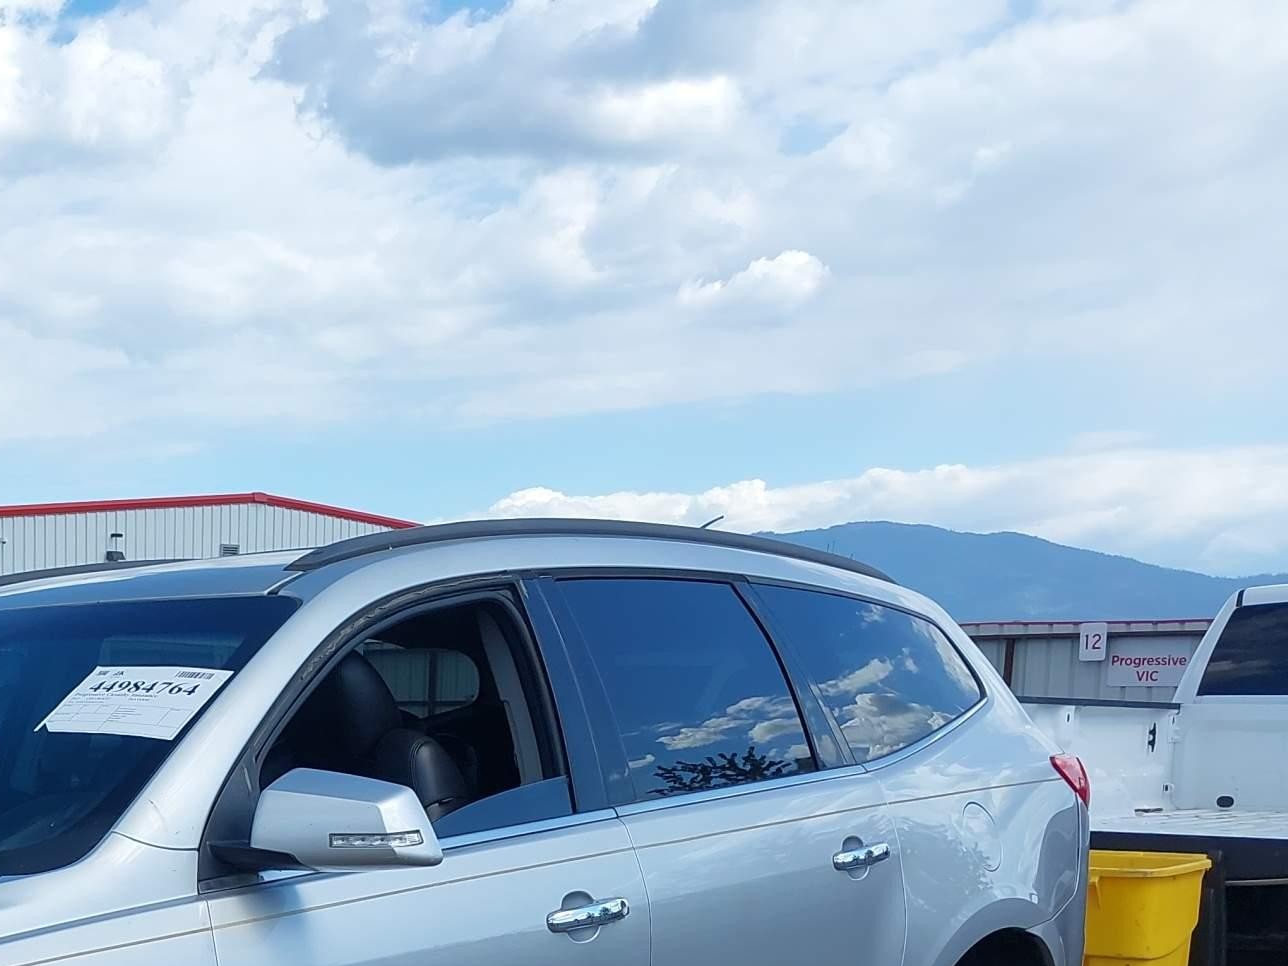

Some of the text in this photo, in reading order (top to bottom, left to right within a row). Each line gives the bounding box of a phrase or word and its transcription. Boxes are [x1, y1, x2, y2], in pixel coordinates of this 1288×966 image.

[1084, 633, 1102, 650] 12
[1111, 654, 1187, 668] Progressive
[1136, 670, 1159, 682] VIC
[89, 681, 200, 695] 44984764
